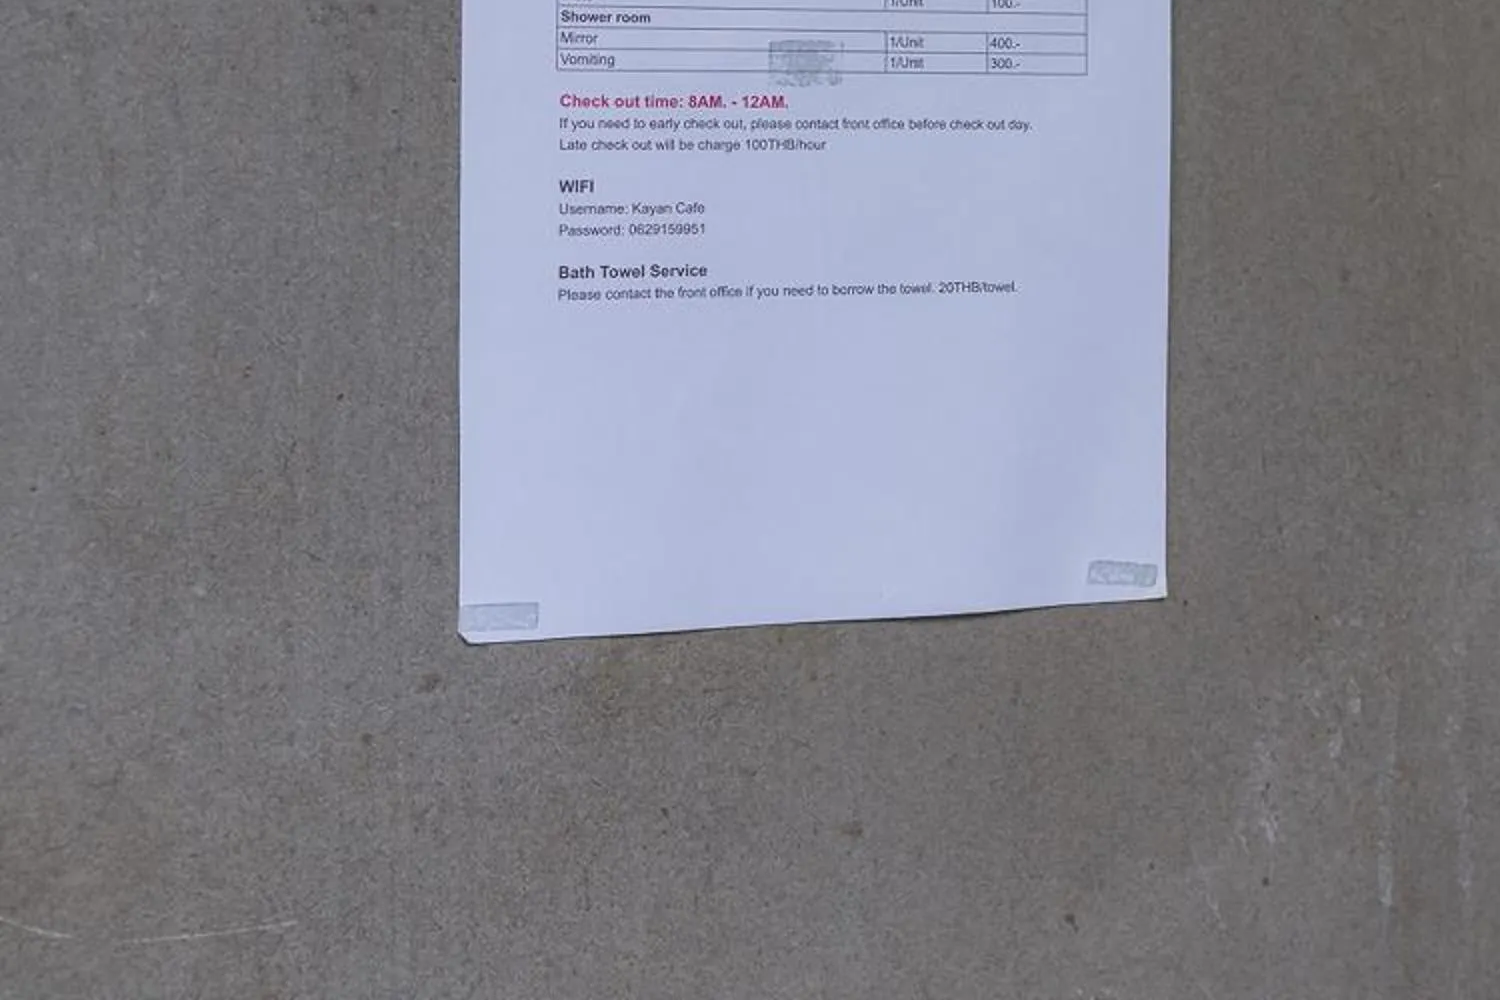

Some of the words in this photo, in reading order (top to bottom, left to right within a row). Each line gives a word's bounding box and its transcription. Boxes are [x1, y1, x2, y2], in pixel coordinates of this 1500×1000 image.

[561, 10, 612, 24] Shower
[616, 12, 651, 24] room
[560, 32, 598, 44] Mirror
[890, 36, 924, 48] 1/Unit
[560, 53, 615, 68] Vomiting
[890, 57, 924, 69] 1/Unit
[560, 94, 609, 108] Check
[615, 95, 640, 108] out
[645, 94, 683, 108] time:
[688, 95, 727, 109] 8AM.
[742, 95, 788, 109] 12AM.
[559, 118, 569, 129] If
[571, 120, 595, 132] you
[599, 118, 630, 129] need
[634, 118, 645, 129] to
[649, 118, 680, 132] early
[683, 118, 720, 130] check
[723, 118, 747, 131] out,
[751, 118, 792, 131] please
[795, 118, 839, 130] contact
[842, 118, 870, 130] front
[873, 117, 905, 130] office
[909, 118, 947, 130] before
[950, 118, 983, 130] check
[987, 118, 1005, 130] out
[1008, 118, 1033, 132] day.
[559, 139, 587, 151] Late
[591, 138, 629, 150] check
[631, 139, 652, 150] out
[655, 138, 675, 150] will
[679, 138, 694, 150] be
[697, 138, 741, 152] charge
[559, 179, 595, 193] WIFI
[559, 204, 628, 216] Username:
[631, 203, 672, 217] Kayan
[675, 202, 705, 214] Cafe
[559, 224, 625, 237] Password:
[559, 265, 595, 279] Bath
[599, 265, 645, 278] Towel
[649, 263, 708, 277] Service
[558, 289, 600, 300] Please
[605, 288, 651, 300] contact
[655, 287, 675, 299] the
[678, 286, 707, 298] front
[709, 285, 743, 297] office
[745, 285, 754, 297] if
[756, 287, 779, 300] you
[783, 285, 813, 297] need
[817, 284, 828, 296] to
[832, 283, 874, 295] borrow
[877, 283, 896, 295] the
